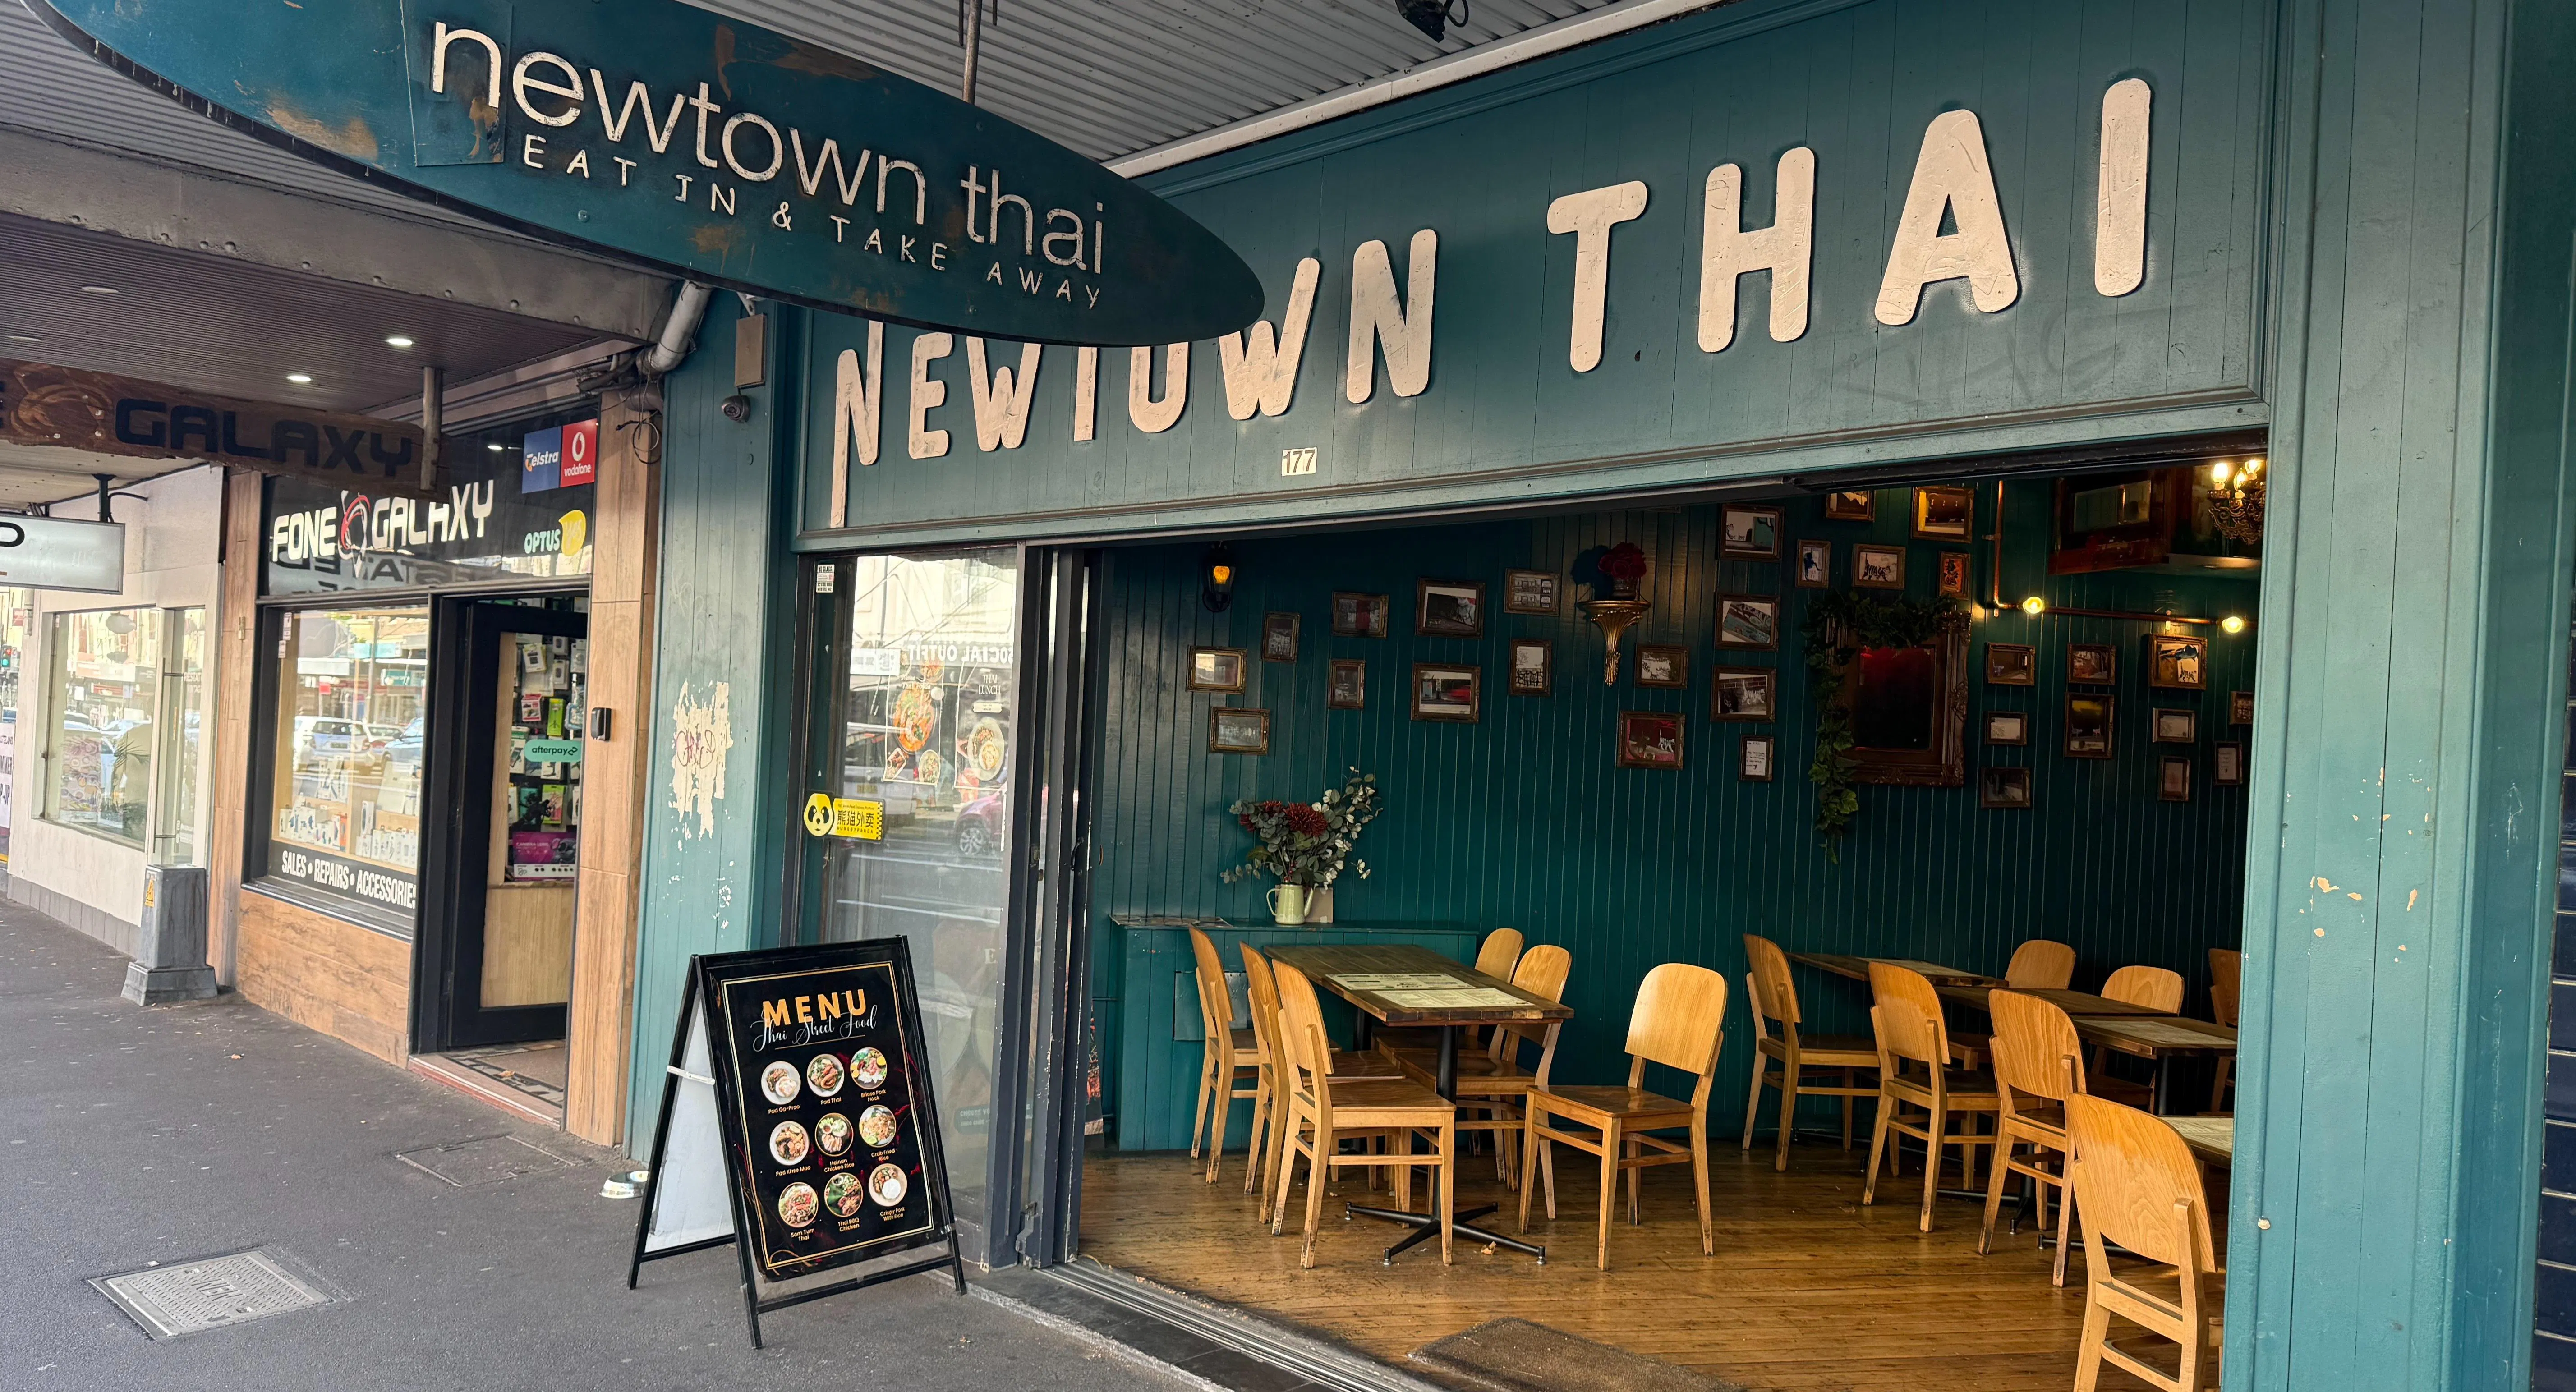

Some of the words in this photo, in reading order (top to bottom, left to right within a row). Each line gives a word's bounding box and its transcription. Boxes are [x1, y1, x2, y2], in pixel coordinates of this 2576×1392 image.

[431, 21, 926, 224] newtown
[961, 164, 1104, 274] thai
[524, 135, 637, 186] EAT
[677, 175, 736, 216] IN
[772, 201, 792, 231] &
[831, 215, 947, 271] TAKE
[987, 262, 1101, 310] AWAY
[1547, 78, 2151, 372] THAI
[116, 399, 412, 477] GALAXY
[525, 451, 559, 472] Telstra
[564, 464, 591, 477] vodafone
[1283, 449, 1315, 474] 177
[272, 506, 337, 562] FONE
[372, 479, 493, 550] GALAXY
[524, 529, 561, 554] OPTUS
[979, 685, 1001, 694] LUNCH
[983, 674, 998, 684] THAI
[532, 746, 568, 756] afterpay
[837, 810, 874, 828] 熊猫外卖
[282, 850, 307, 878] SALES
[314, 859, 350, 890] REPAIRS
[763, 989, 866, 1029] MENU
[750, 1008, 788, 1052] Thai
[792, 1014, 835, 1045] Street
[839, 1004, 878, 1039] Food
[824, 1165, 844, 1173] Chicken
[830, 1158, 848, 1167] Hainan
[839, 1223, 860, 1232] Chicken
